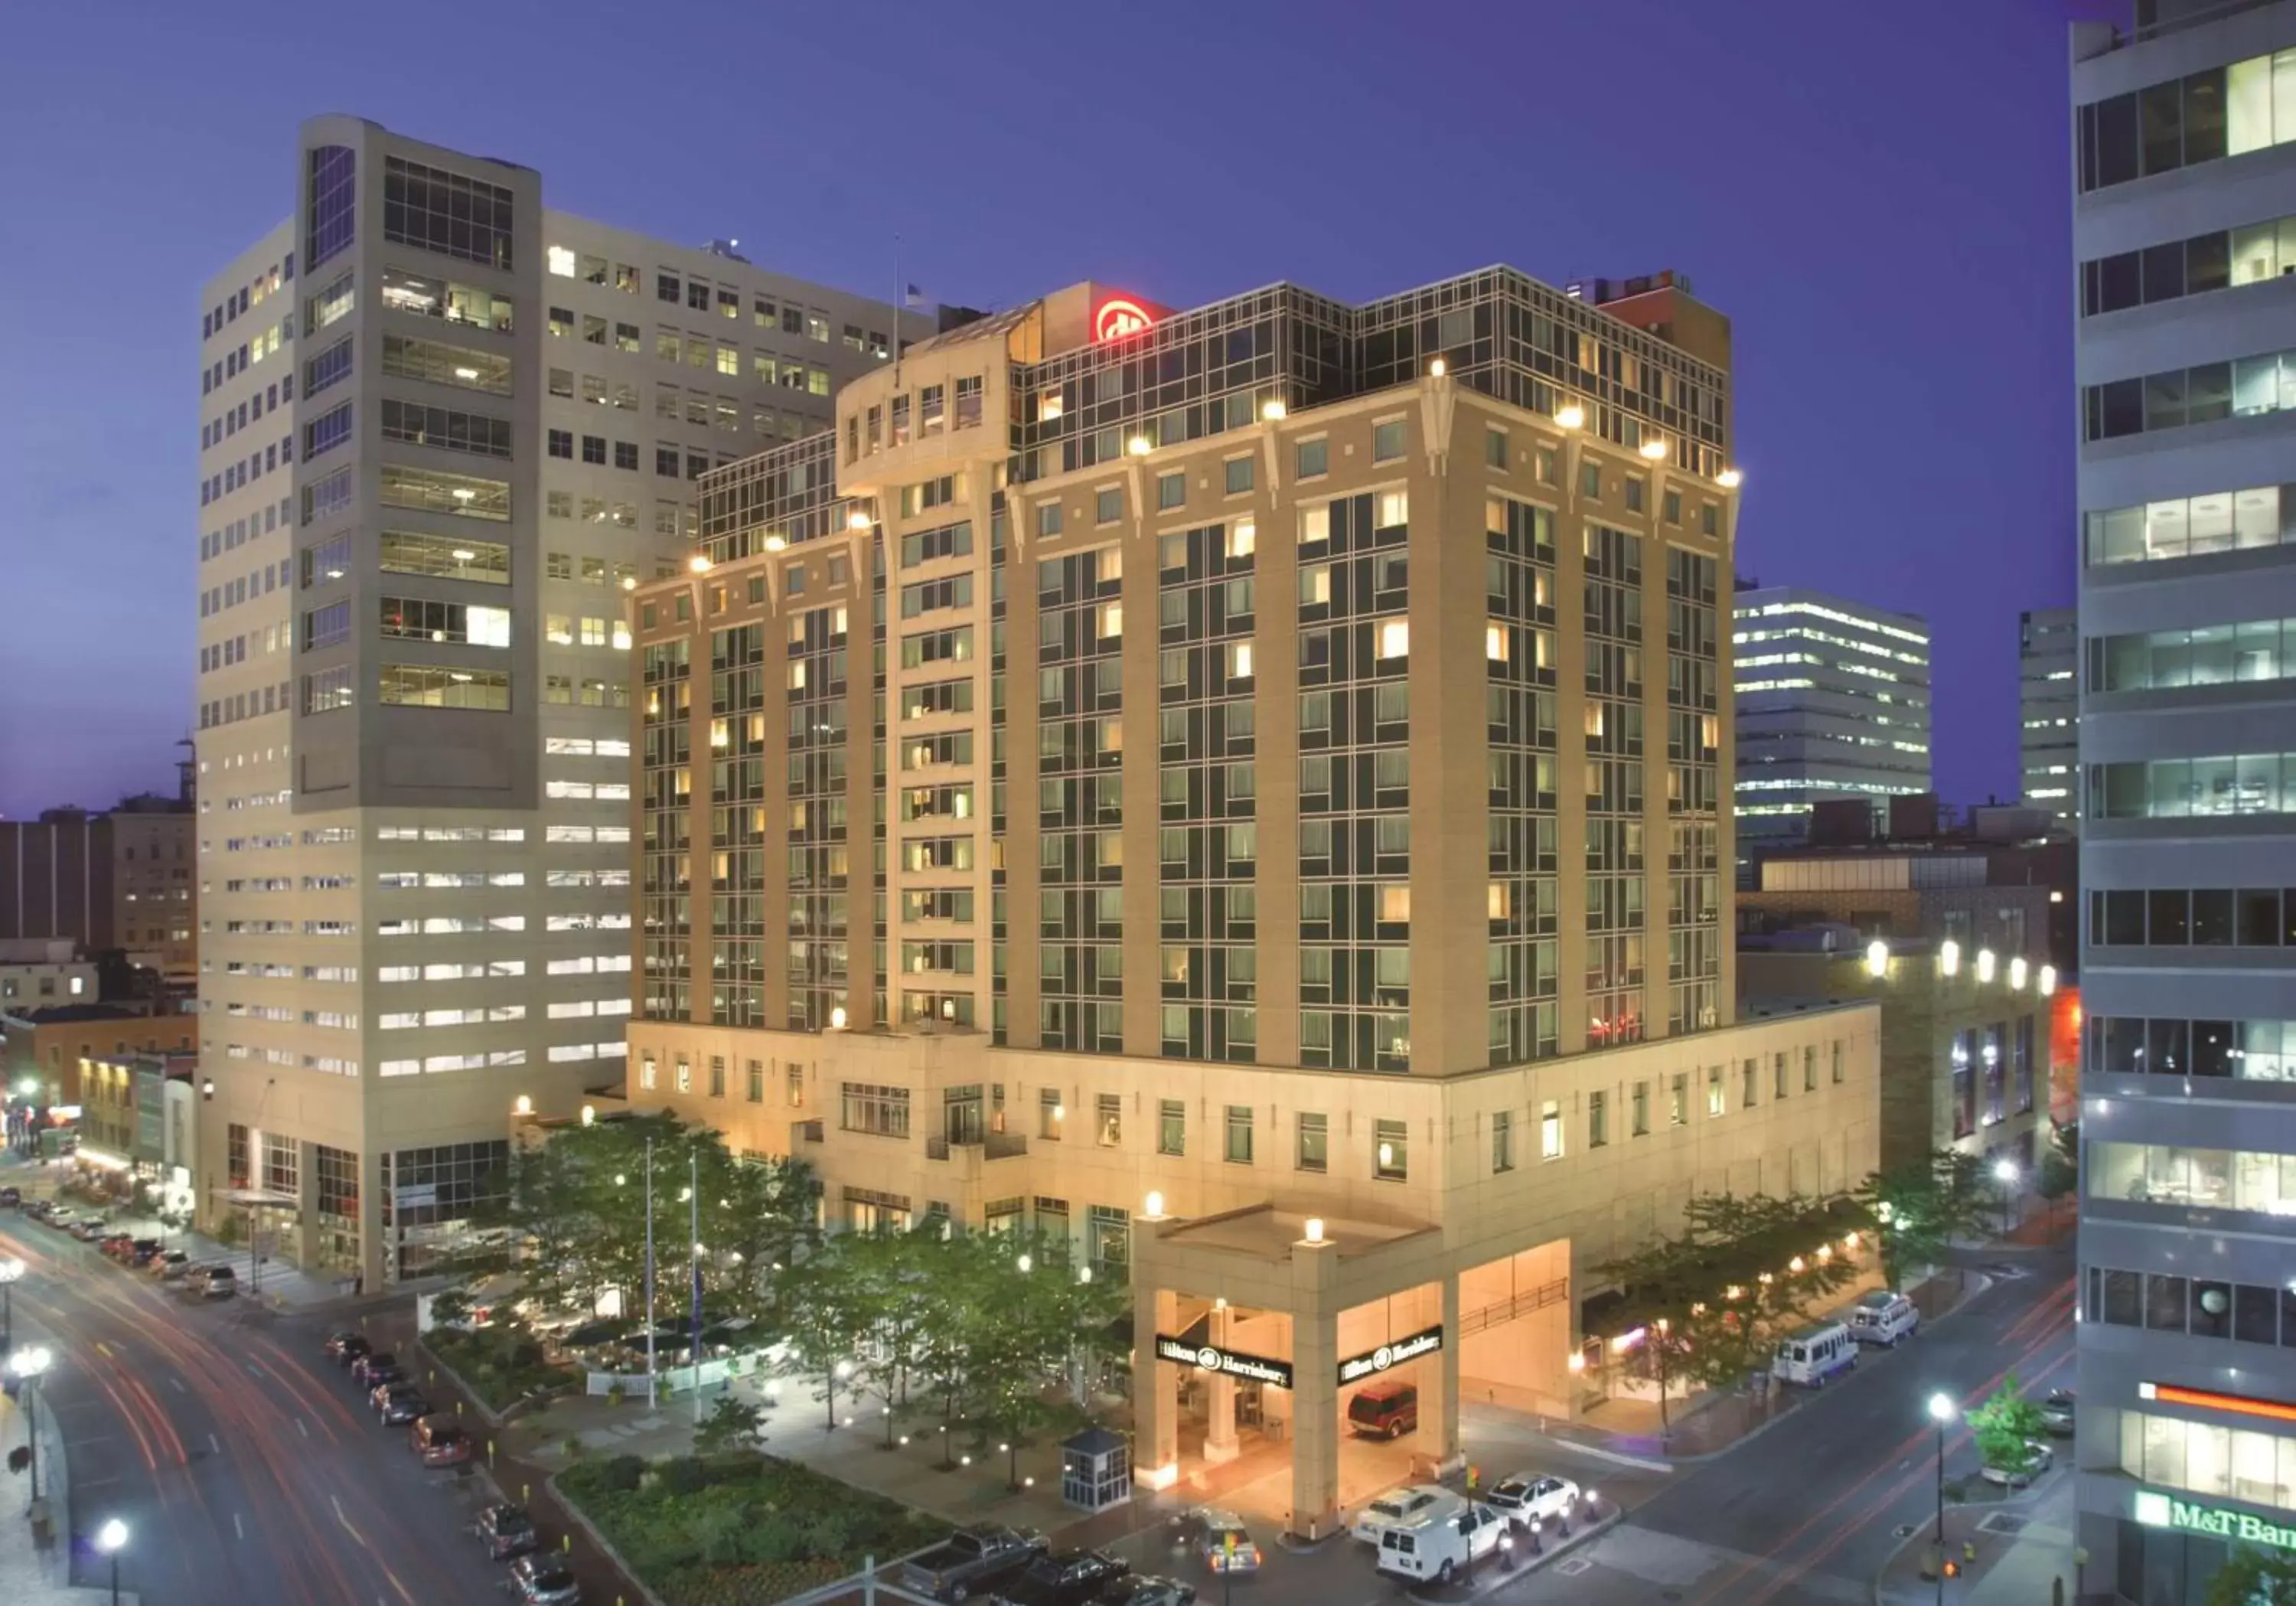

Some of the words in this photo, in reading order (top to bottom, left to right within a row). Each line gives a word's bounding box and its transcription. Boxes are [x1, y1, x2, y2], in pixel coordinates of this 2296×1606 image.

[1159, 1340, 1196, 1362] Hilton
[1223, 1355, 1288, 1386] Harrisburg
[2173, 1501, 2236, 1536] M&T
